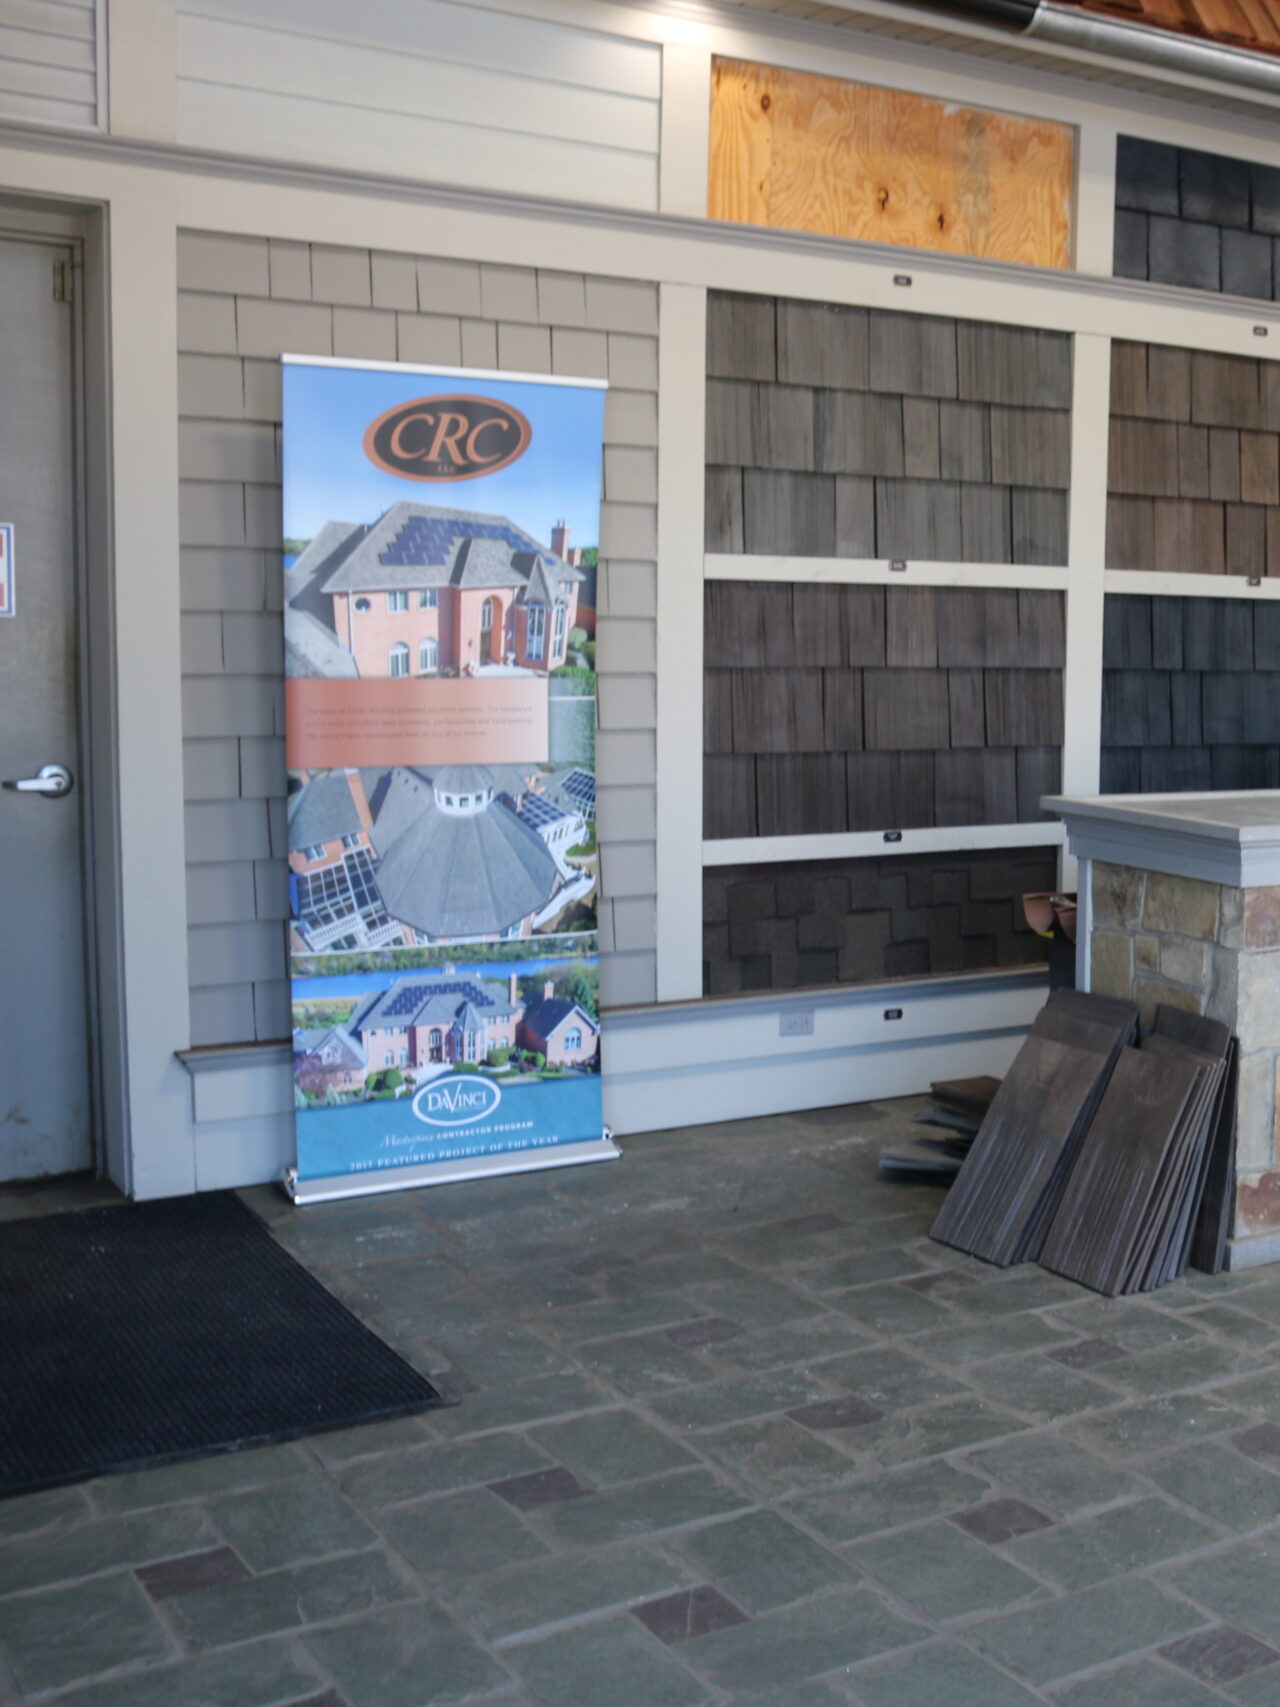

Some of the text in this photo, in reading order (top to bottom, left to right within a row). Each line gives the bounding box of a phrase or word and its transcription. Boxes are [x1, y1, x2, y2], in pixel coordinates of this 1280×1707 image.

[390, 412, 509, 466] CRC
[436, 1126, 491, 1141] CONTRACTOR
[494, 1120, 534, 1132] PROGRAM
[377, 1151, 435, 1168] FEATURED
[439, 1144, 485, 1159] PROJECT
[490, 1141, 504, 1152] OF
[508, 1139, 528, 1150] THE
[532, 1135, 559, 1147] YEAR
